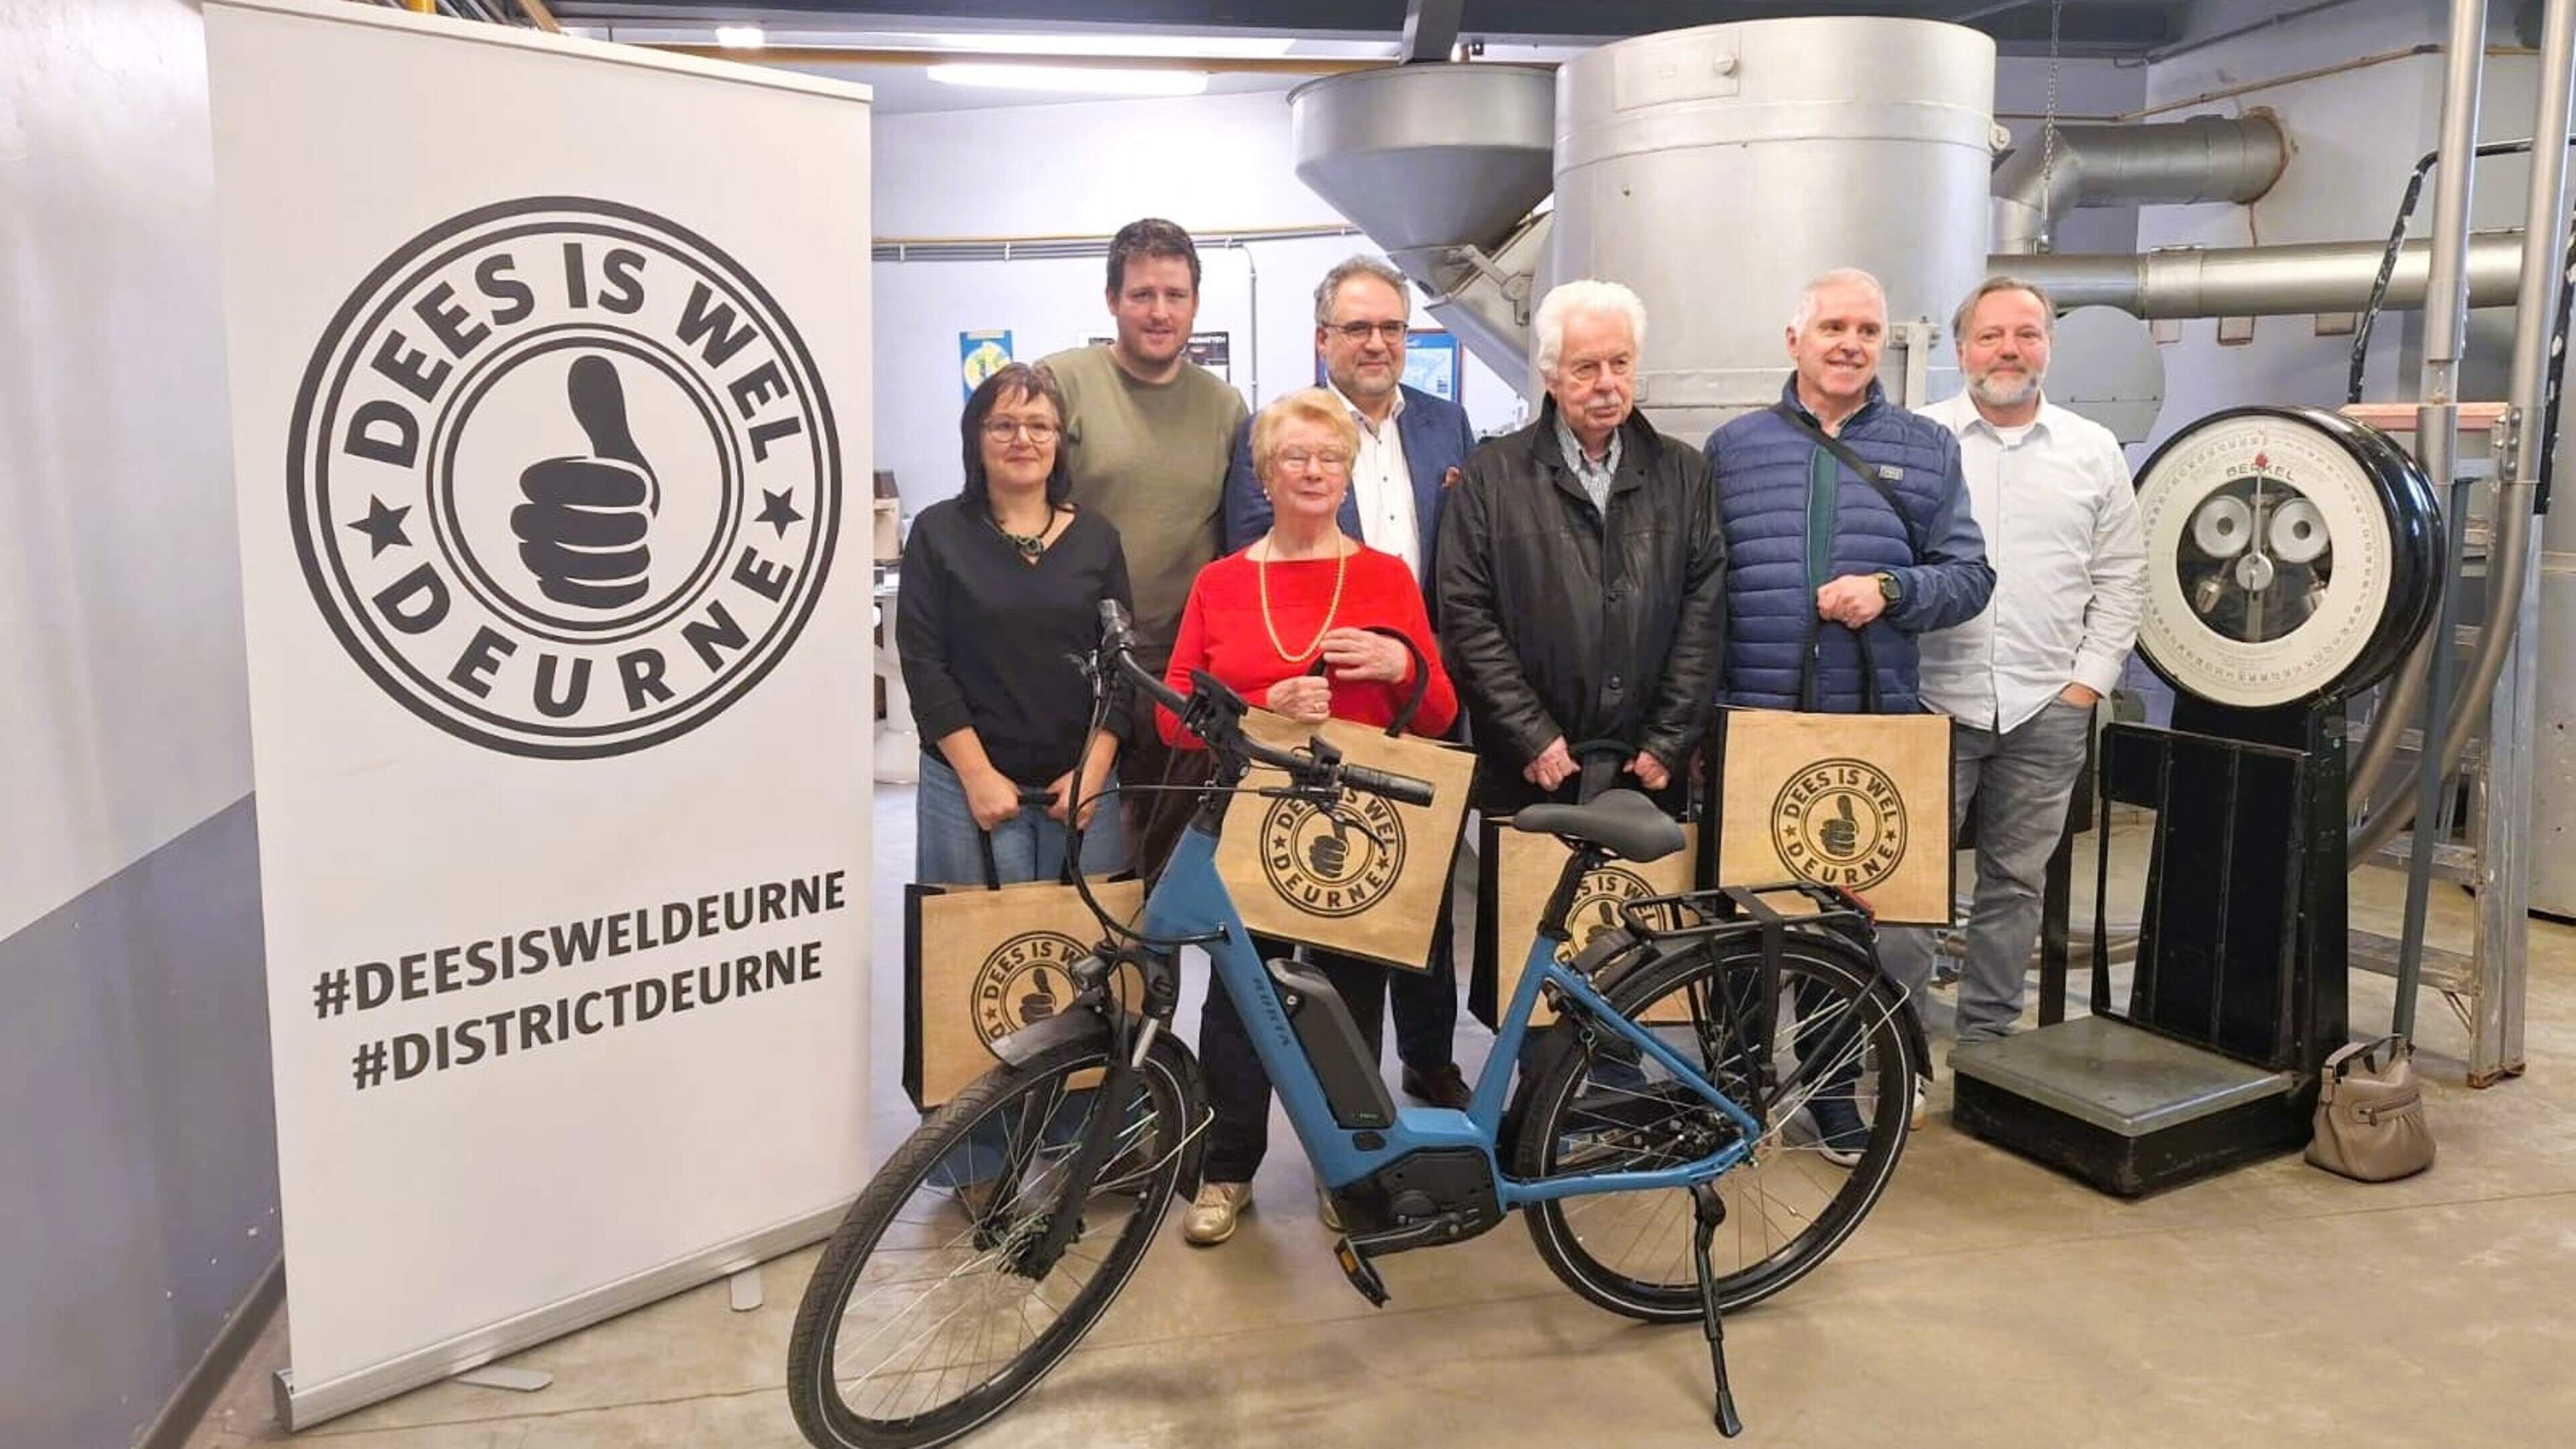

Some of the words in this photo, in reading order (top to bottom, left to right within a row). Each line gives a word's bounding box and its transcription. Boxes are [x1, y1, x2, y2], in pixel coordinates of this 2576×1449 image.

[343, 254, 535, 468] DEES
[563, 242, 647, 315] IS
[675, 281, 802, 463] WEL
[372, 545, 793, 718] DEURNE
[1783, 771, 1831, 819] DEES
[1838, 768, 1860, 785] IS
[1866, 775, 1897, 822] WEL
[1273, 853, 1383, 908] DEURNE
[1598, 875, 1617, 891] IS
[1787, 841, 1894, 884] DEURNE
[313, 870, 845, 1019] #DEESISWELDEURNE
[983, 947, 1025, 999] DEES
[1032, 942, 1052, 957] IS
[352, 941, 822, 1090] #DISTRICTDEURNE
